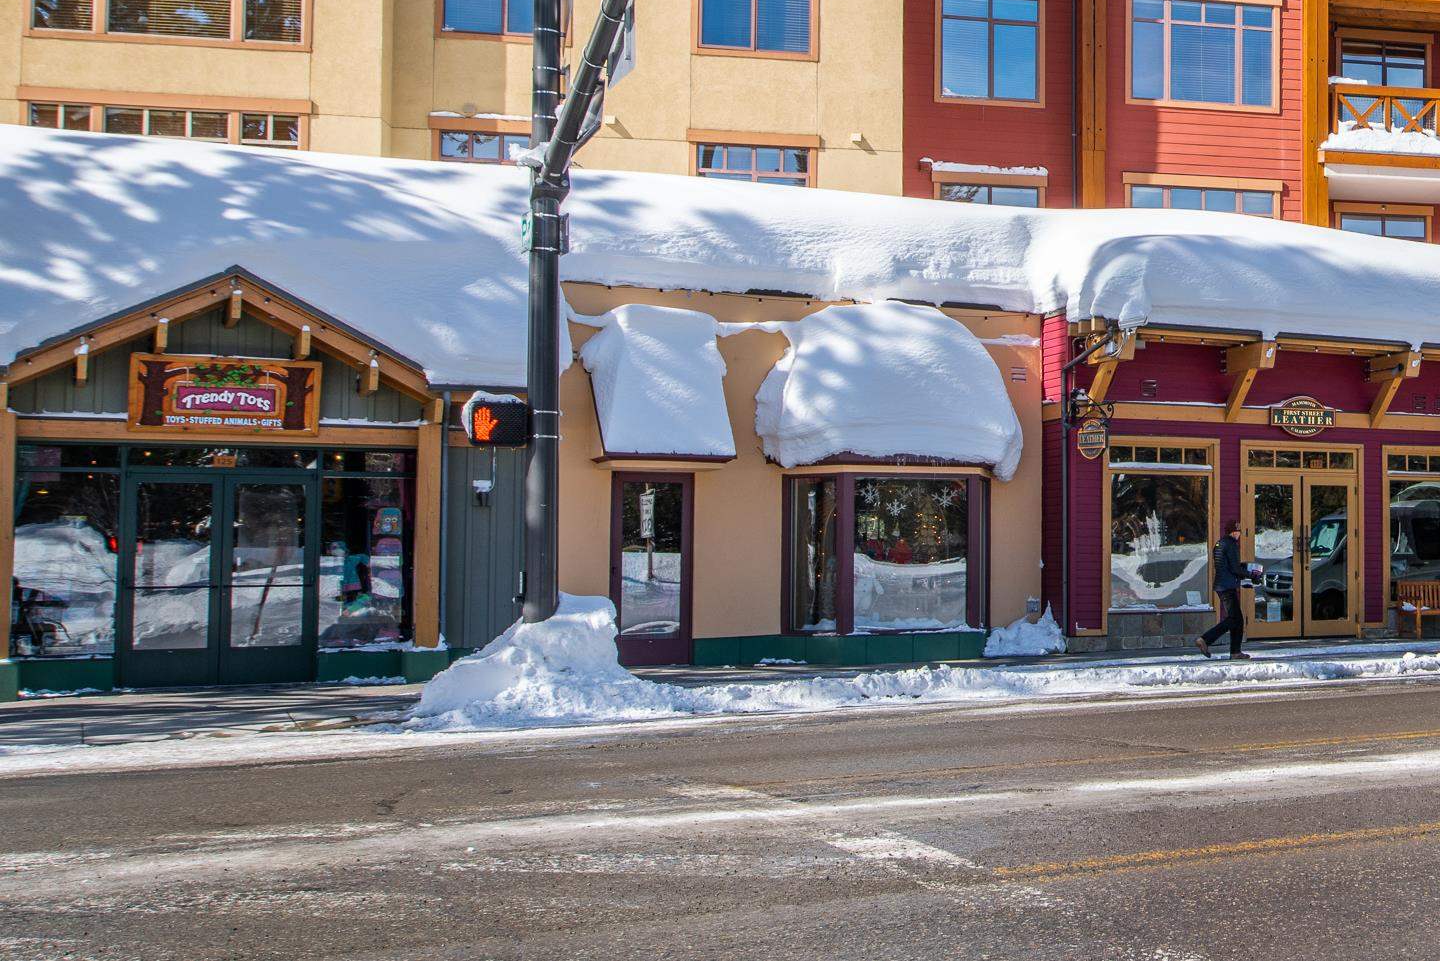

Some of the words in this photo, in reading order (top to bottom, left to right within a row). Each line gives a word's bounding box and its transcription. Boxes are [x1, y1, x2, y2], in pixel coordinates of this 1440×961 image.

[182, 390, 235, 408] Trendy
[236, 391, 271, 410] Tots
[165, 415, 186, 423] TOYS
[188, 416, 223, 425] STUFFED
[223, 417, 257, 426] ANIMALS
[261, 419, 283, 427] GIFTS
[1274, 415, 1333, 425] LEATHER
